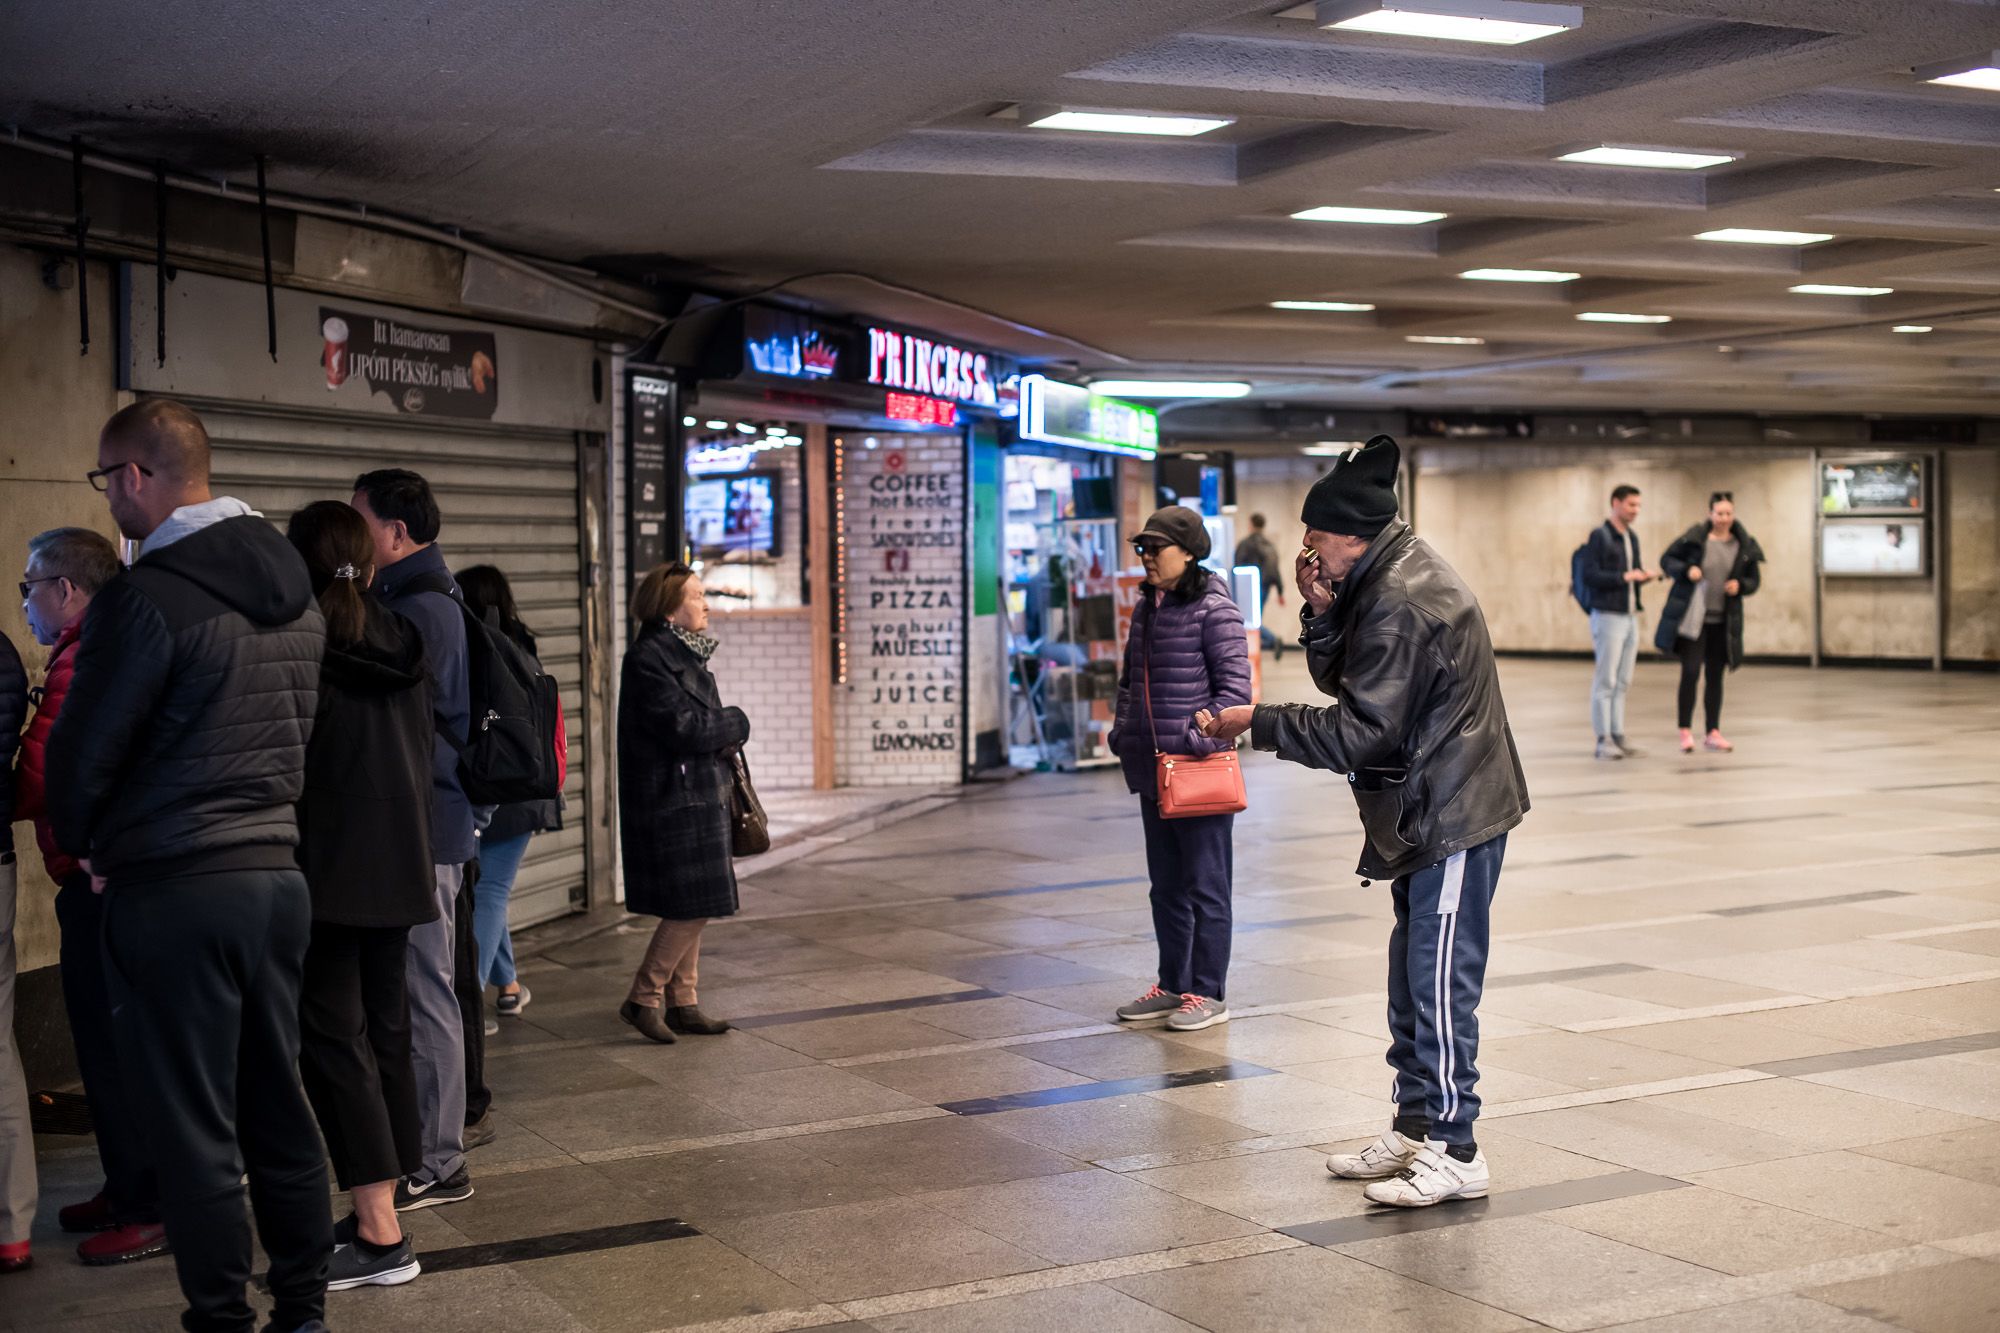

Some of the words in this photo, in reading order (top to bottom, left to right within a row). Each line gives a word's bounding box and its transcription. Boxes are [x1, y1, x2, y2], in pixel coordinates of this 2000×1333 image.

[374, 319, 386, 344] Itt
[390, 322, 451, 352] hamarosan
[349, 348, 390, 381] LIPÓTI
[392, 352, 439, 387] PÉKSÉG
[868, 326, 997, 405] PRINCESS
[869, 474, 951, 493] COFFEE
[869, 495, 899, 509] hot
[870, 514, 952, 529] fresh
[871, 531, 956, 548] SANDWICHES
[870, 591, 953, 609] PIZZA
[871, 639, 953, 657] MUESLI
[872, 668, 955, 681] fresh
[872, 685, 955, 704] JUICE
[872, 714, 955, 730] cold
[872, 733, 956, 751] LEMONADES
